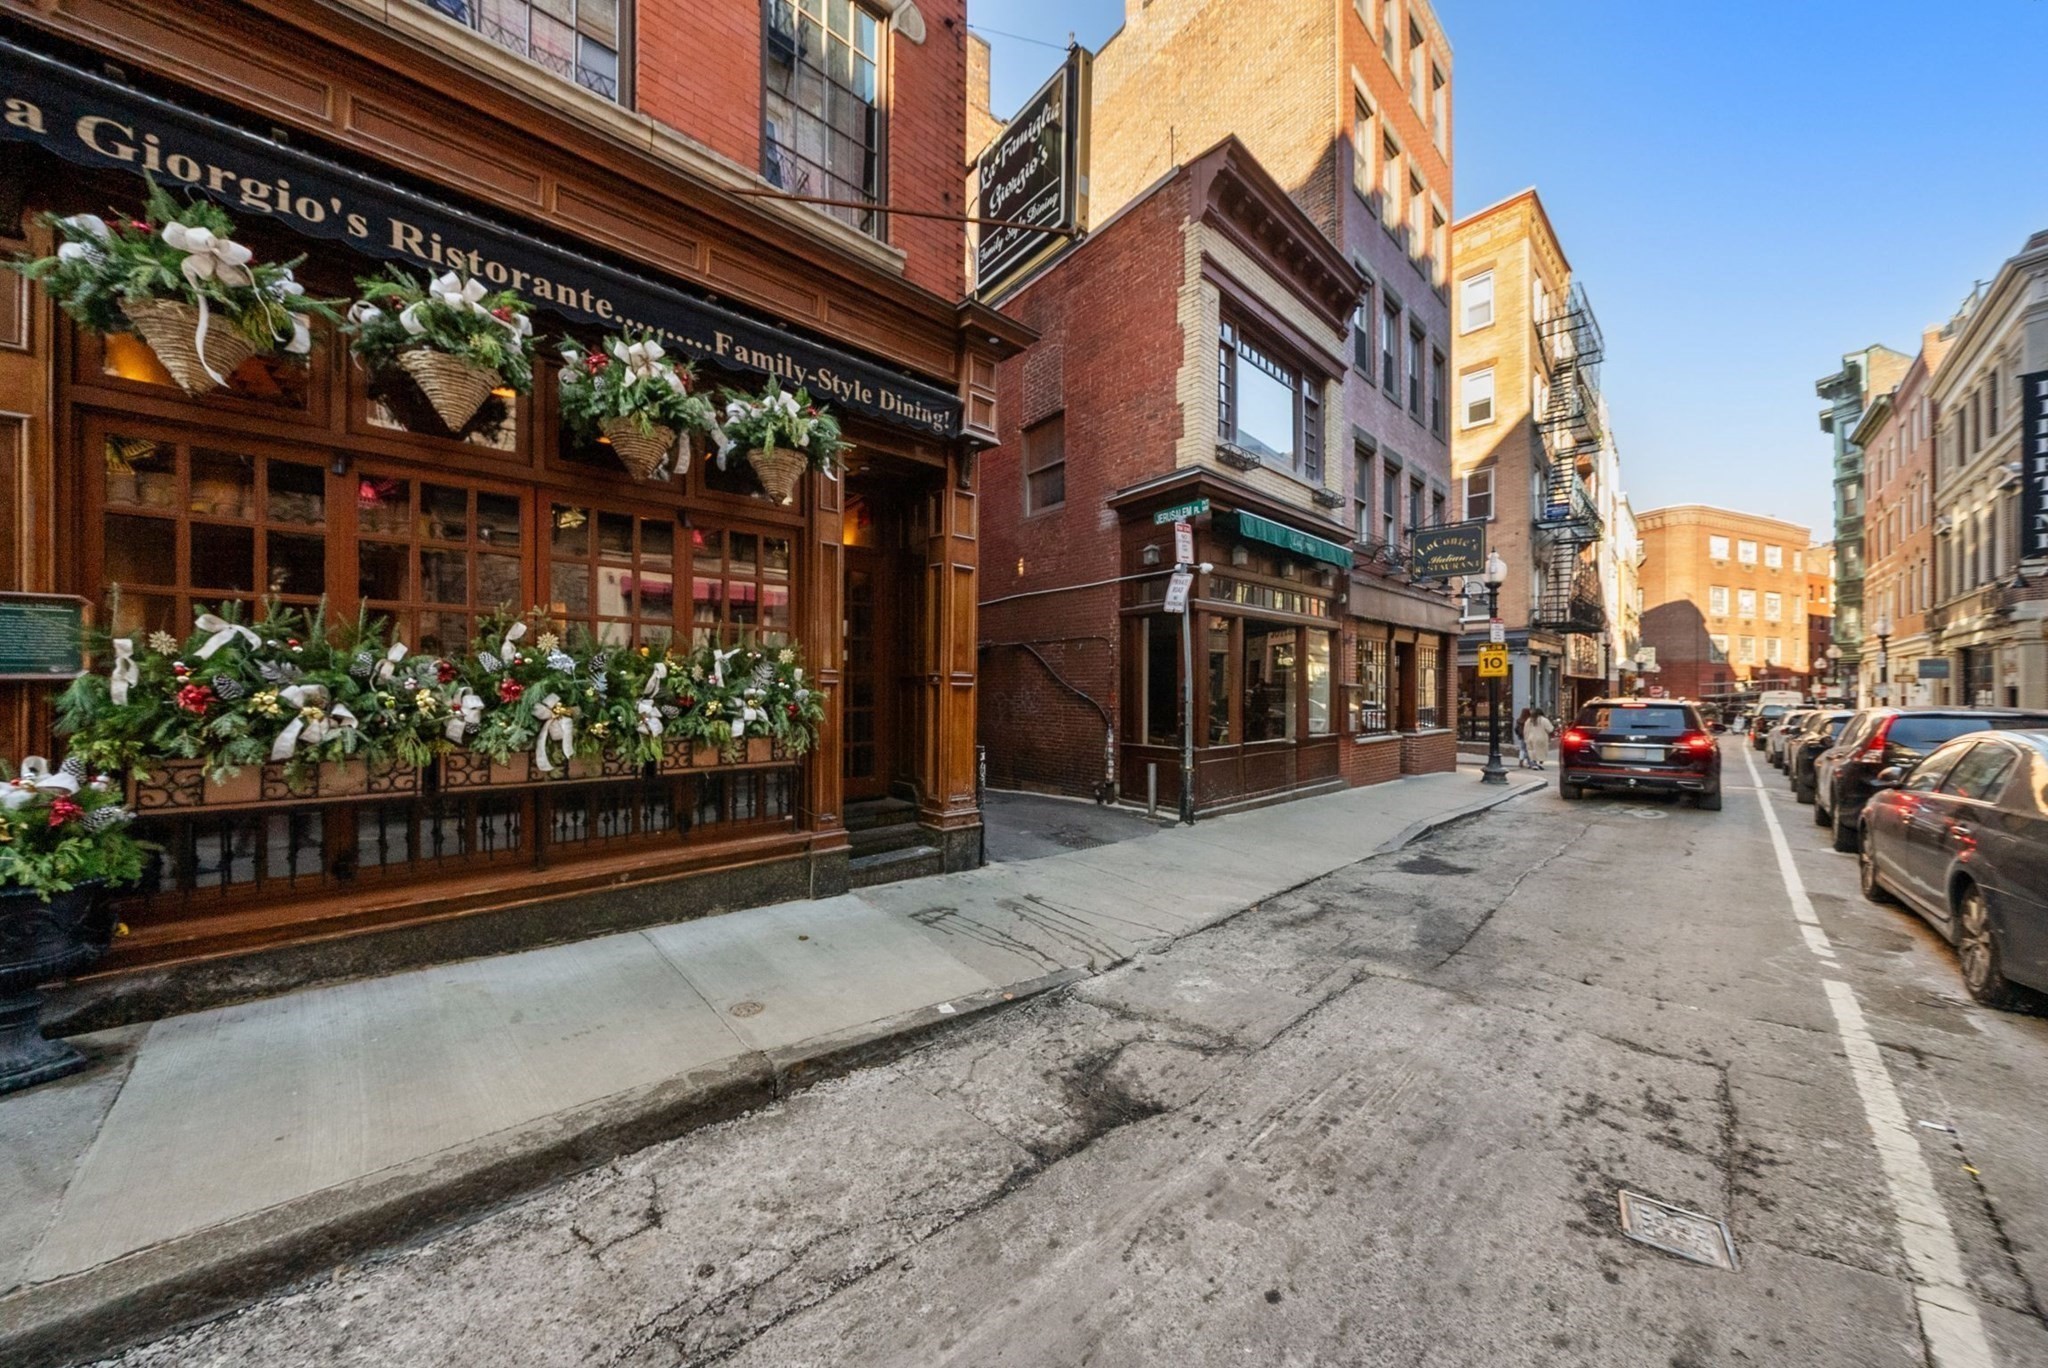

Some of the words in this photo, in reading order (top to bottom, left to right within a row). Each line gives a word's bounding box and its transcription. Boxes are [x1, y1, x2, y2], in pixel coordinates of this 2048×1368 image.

[995, 102, 1061, 168] Famiglia
[989, 144, 1048, 218] Giorgio's
[1027, 192, 1060, 224] Dining
[76, 115, 369, 238] Giorgio's
[878, 387, 950, 432] Dining!
[1156, 506, 1193, 525] JERUSALEM
[1483, 658, 1503, 669] 10
